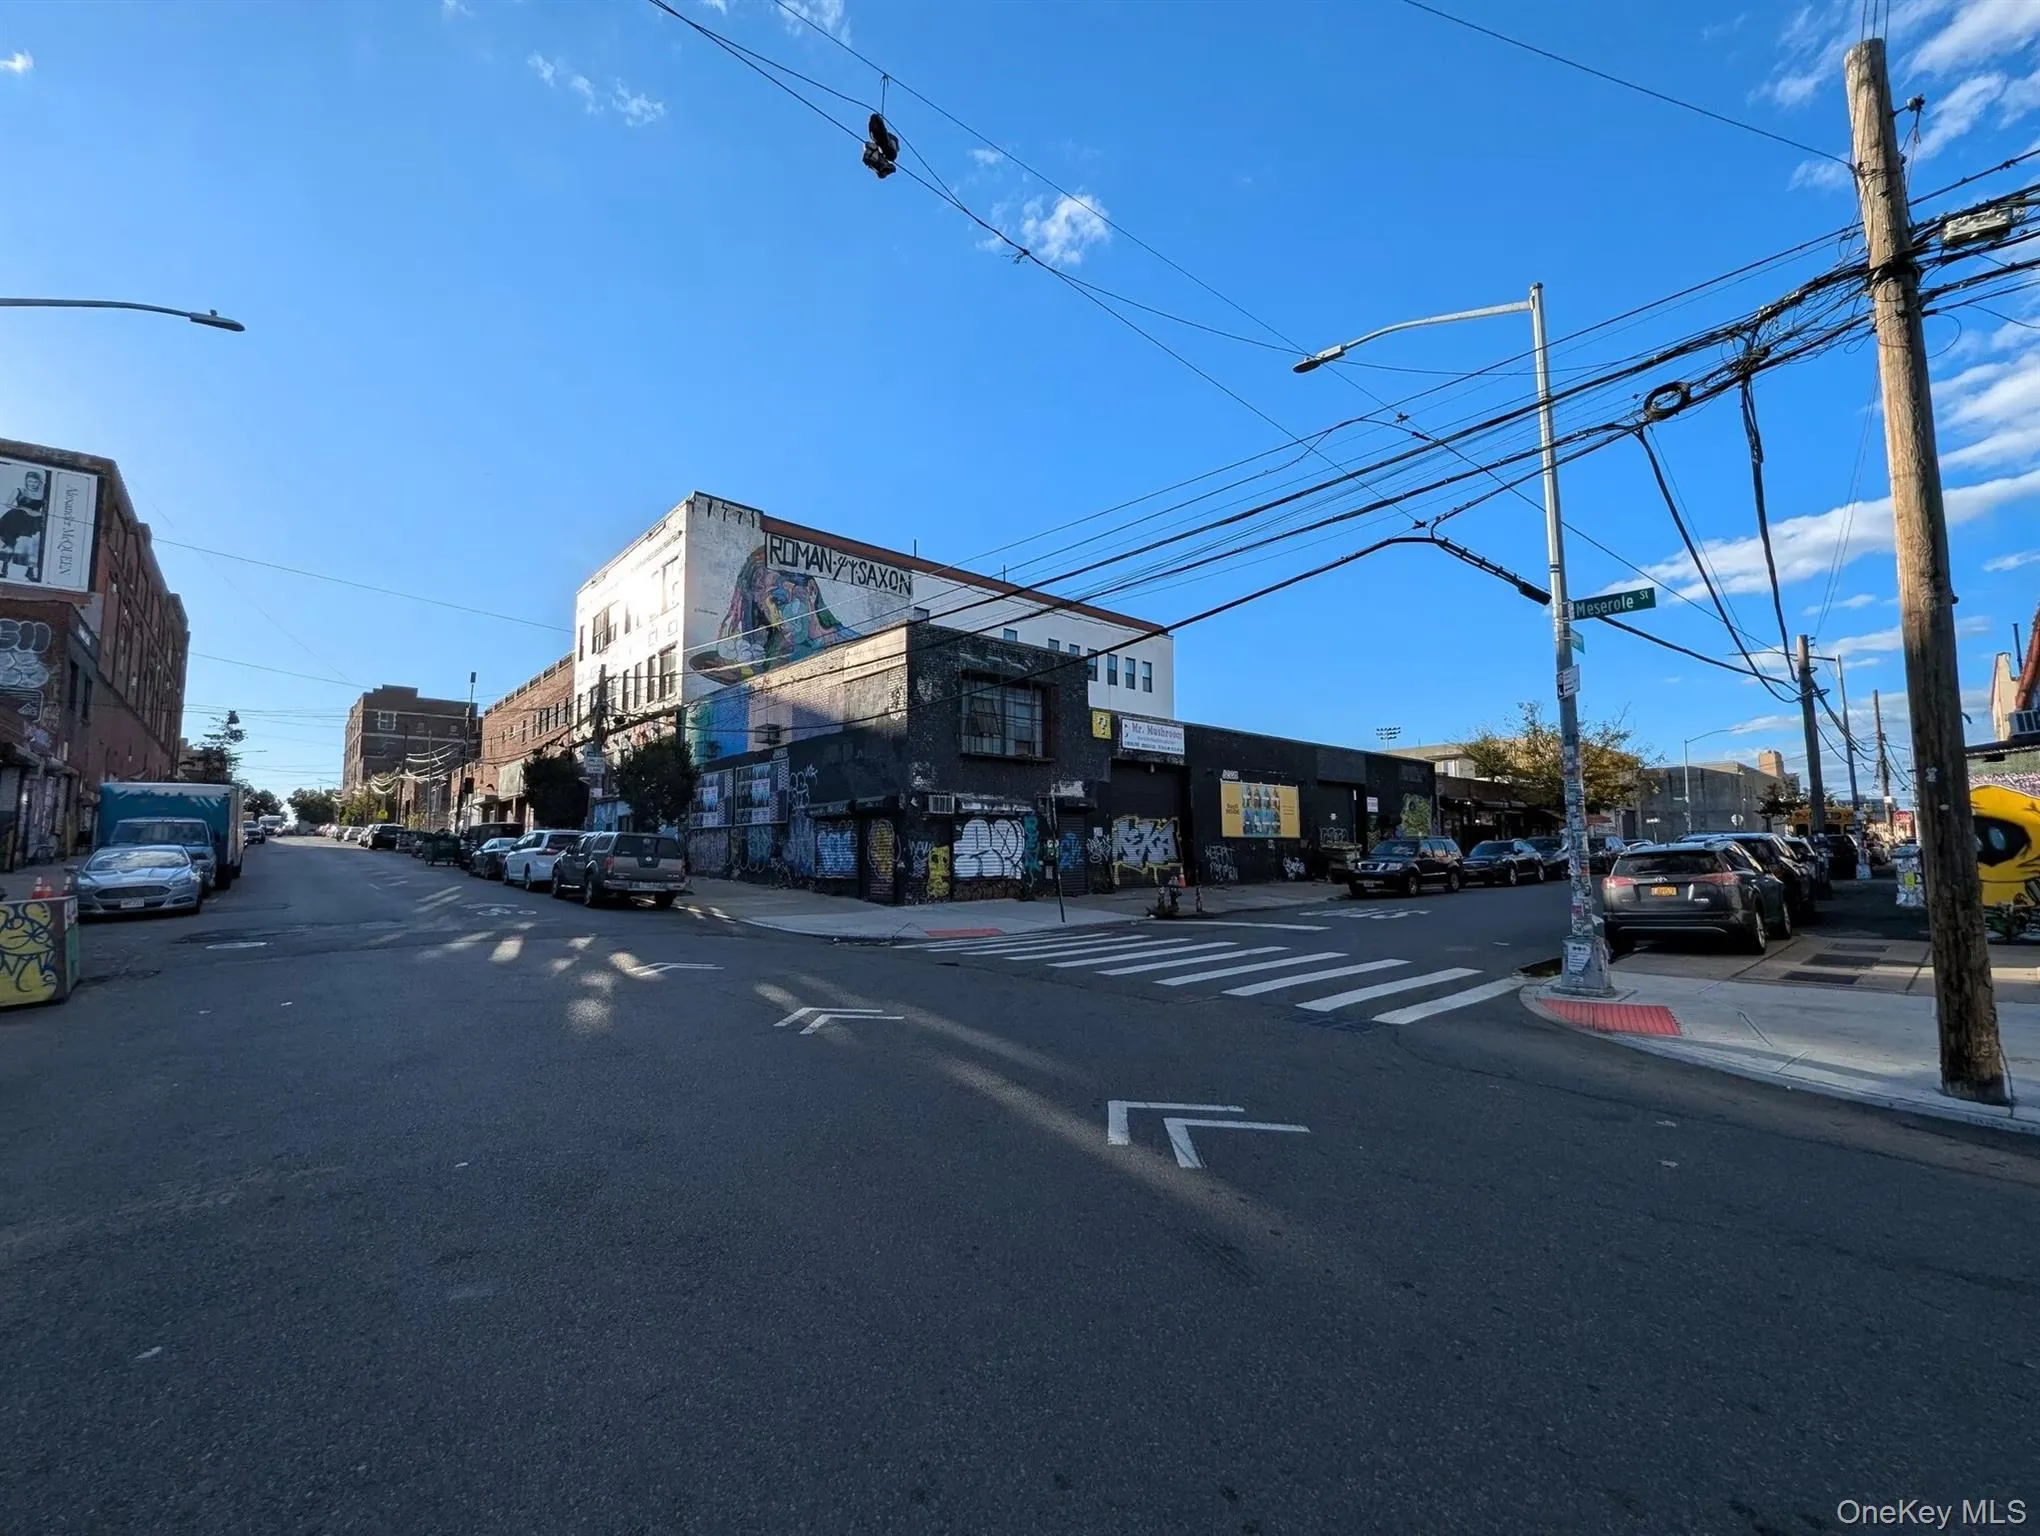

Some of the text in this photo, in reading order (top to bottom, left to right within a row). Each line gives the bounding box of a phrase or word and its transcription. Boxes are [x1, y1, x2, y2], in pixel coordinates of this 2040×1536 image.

[769, 535, 911, 595] ROMAN SAXON
[1575, 589, 1649, 617] Meserole St
[1131, 722, 1145, 734] Mr.
[1147, 725, 1183, 740] Mushroom
